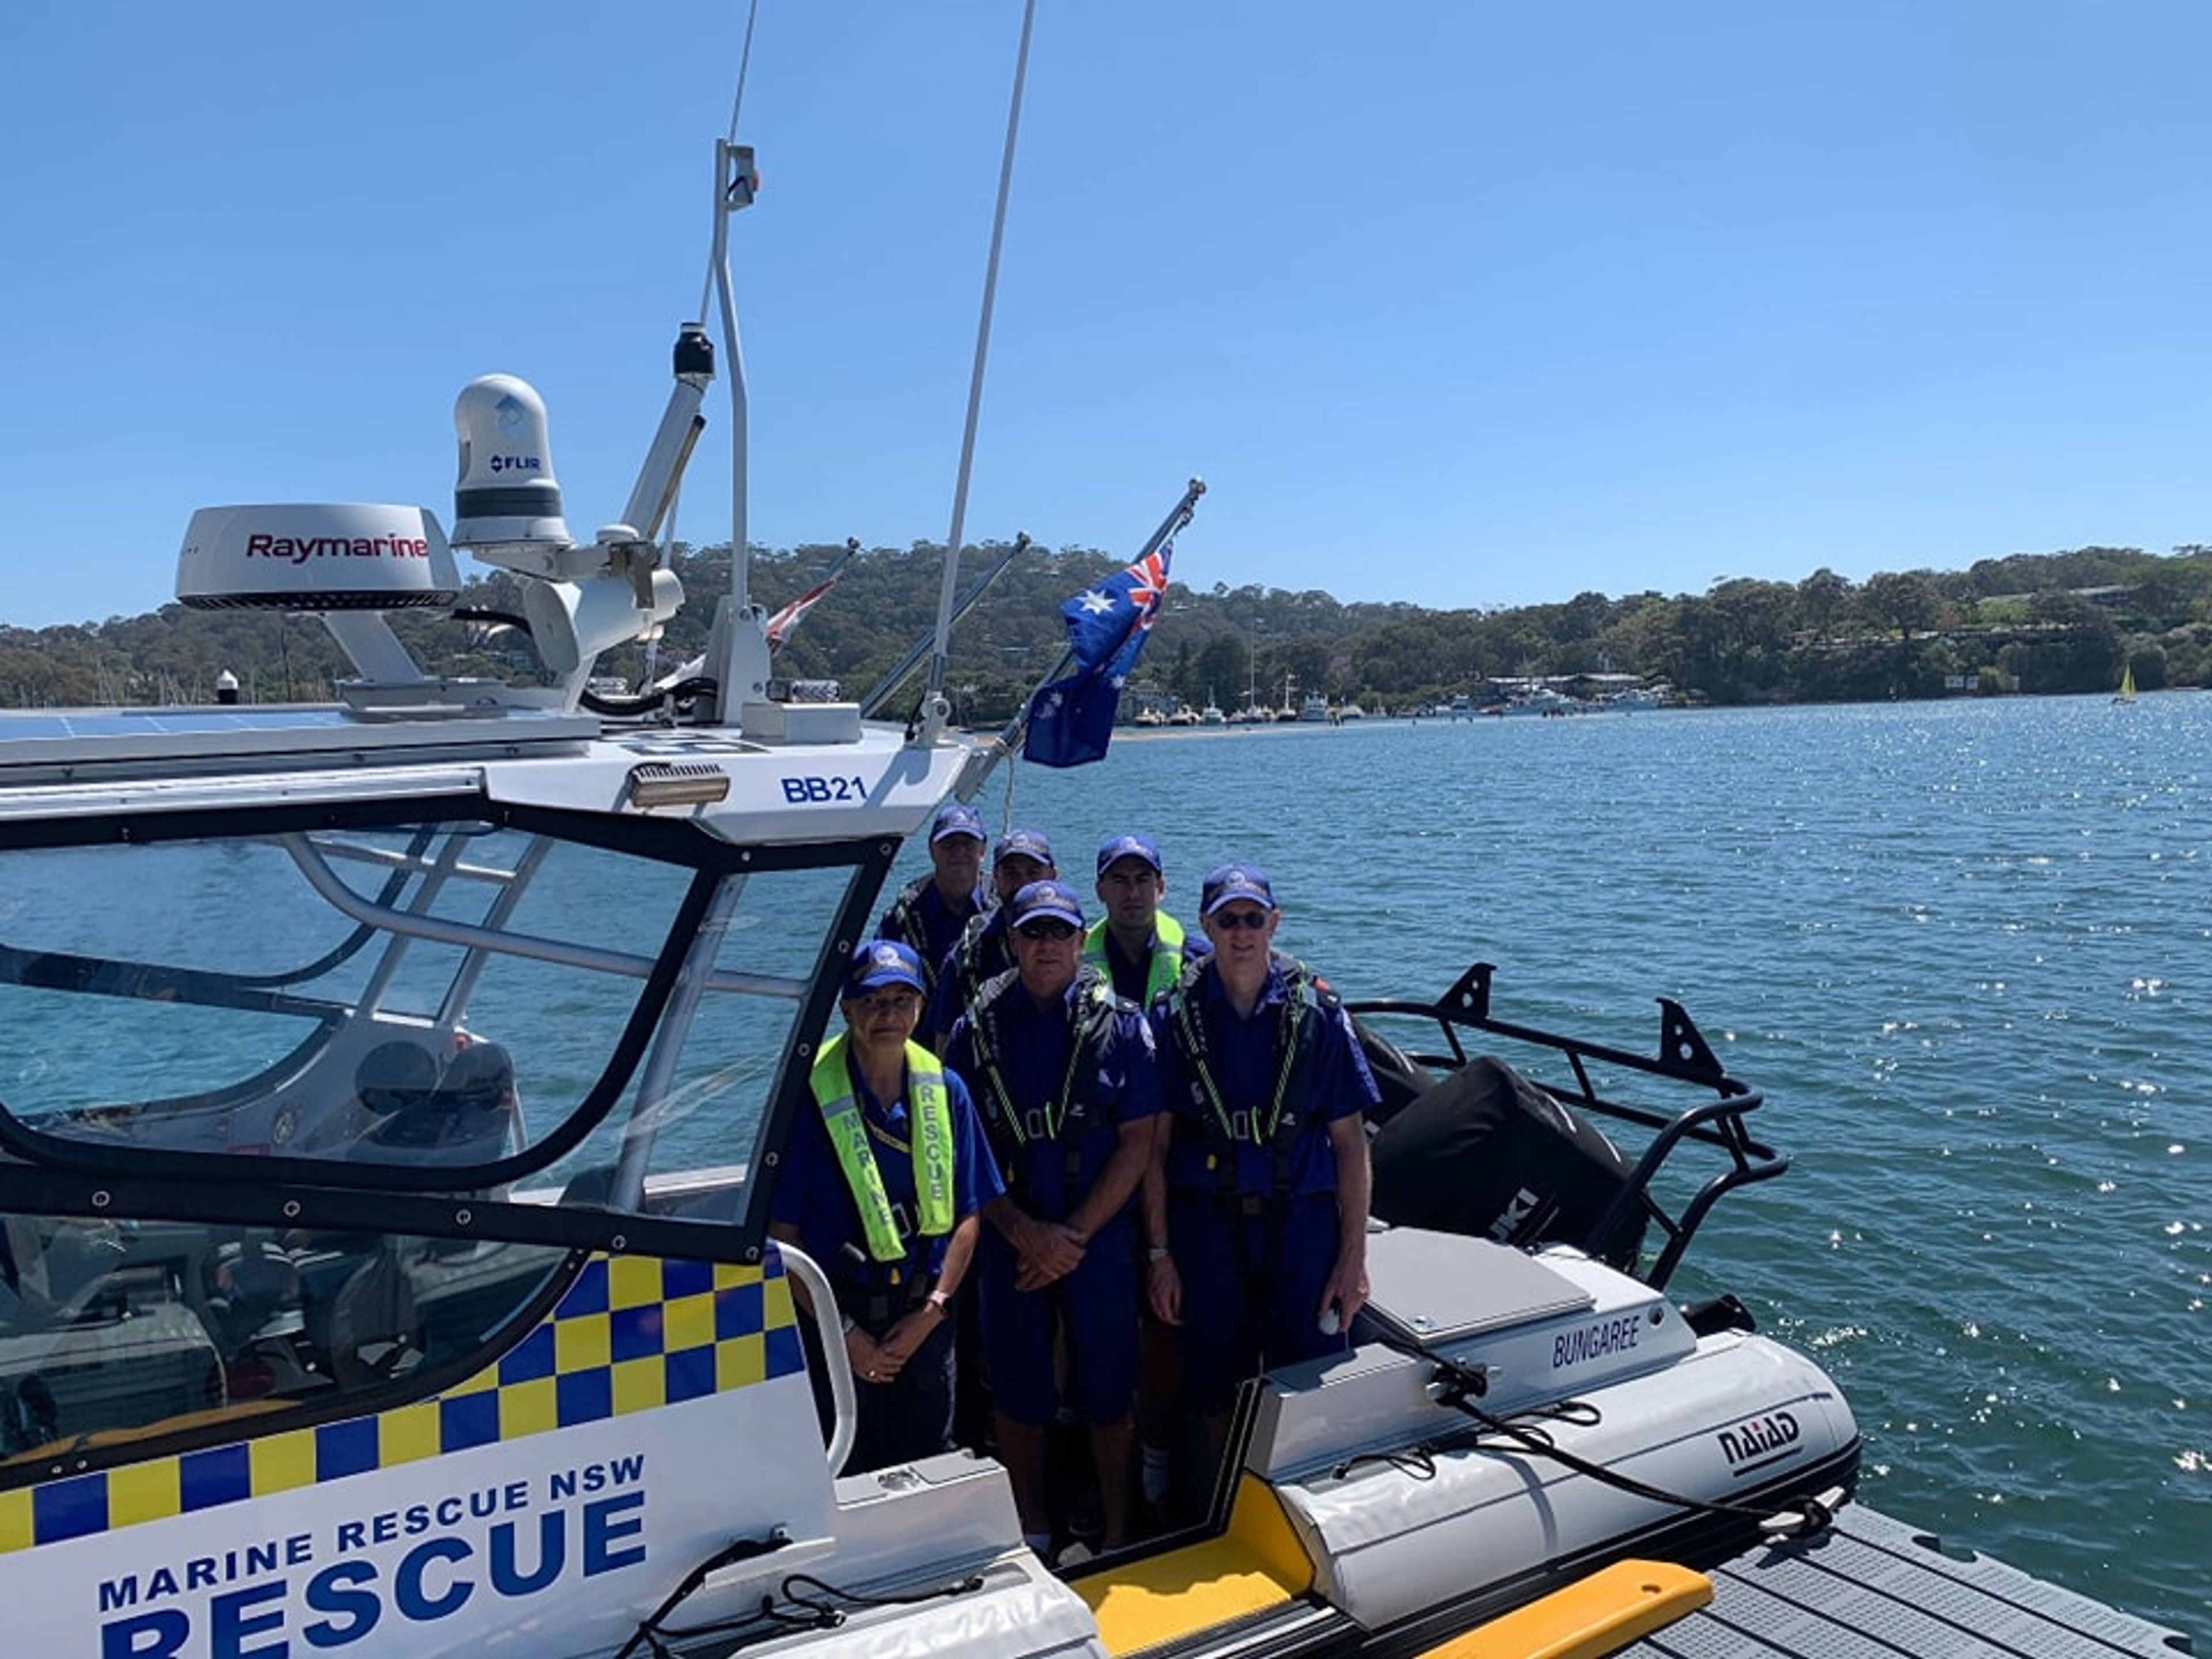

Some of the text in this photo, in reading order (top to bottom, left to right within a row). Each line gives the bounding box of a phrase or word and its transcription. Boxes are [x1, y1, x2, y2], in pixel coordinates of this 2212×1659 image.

[505, 456, 541, 471] FLIR
[246, 533, 429, 565] Raymarine
[781, 777, 868, 804] BB21
[843, 1110, 892, 1225] MARINE
[922, 1085, 942, 1201] RESCUE
[1553, 1315, 1640, 1369] BUNGAREE
[99, 1455, 644, 1612] MARINE RESCUE NSW
[101, 1491, 646, 1659] RESCUE
